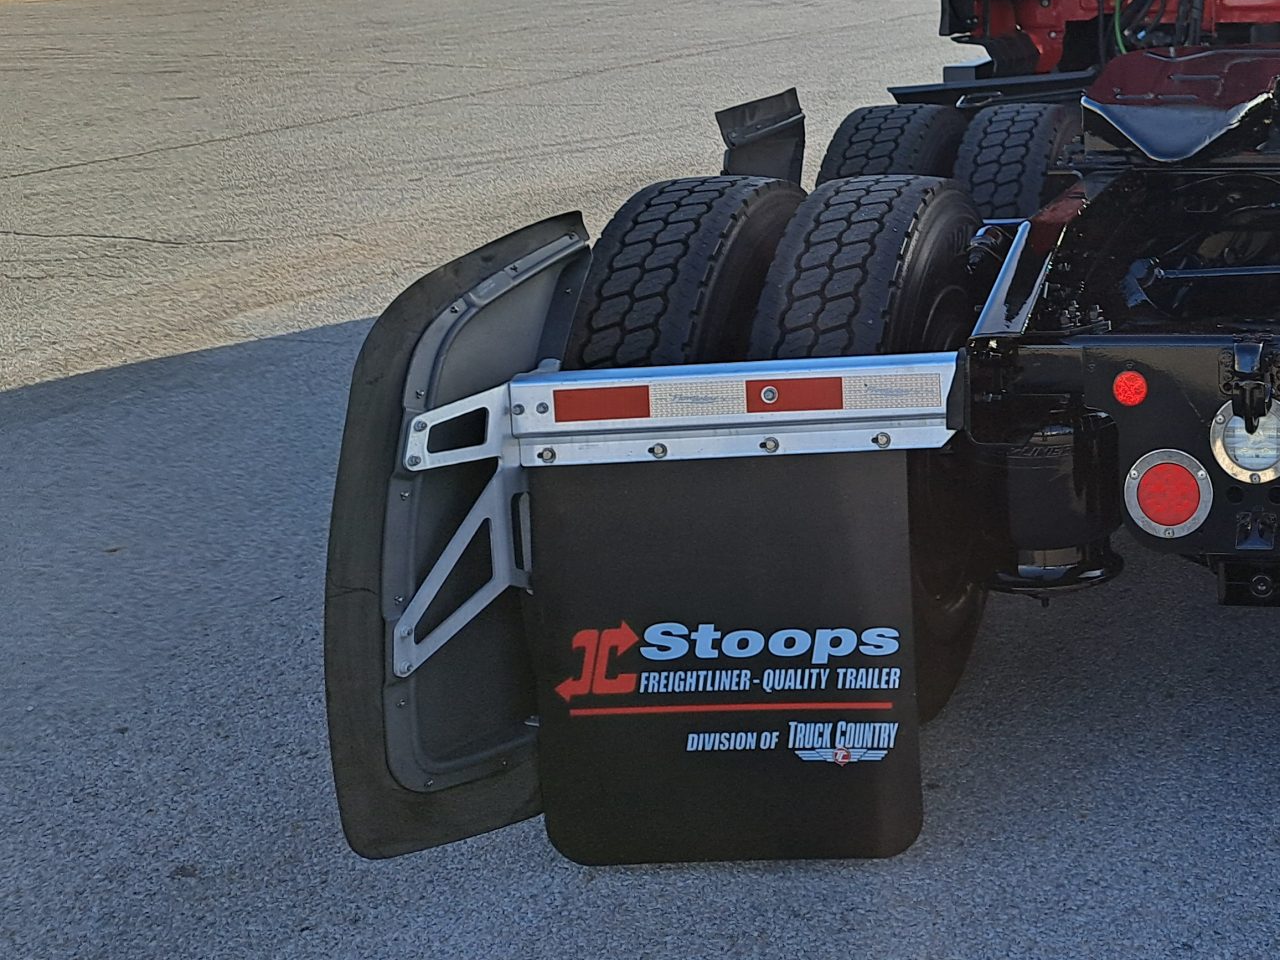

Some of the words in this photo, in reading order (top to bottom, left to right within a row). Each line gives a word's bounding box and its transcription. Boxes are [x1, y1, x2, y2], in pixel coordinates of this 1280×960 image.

[640, 622, 900, 664] Stoops
[836, 668, 901, 690] TRAILER
[686, 732, 756, 752] DIVISION
[760, 731, 779, 750] OF
[788, 721, 832, 748] TRUCK
[835, 720, 898, 748] COUNTRY
